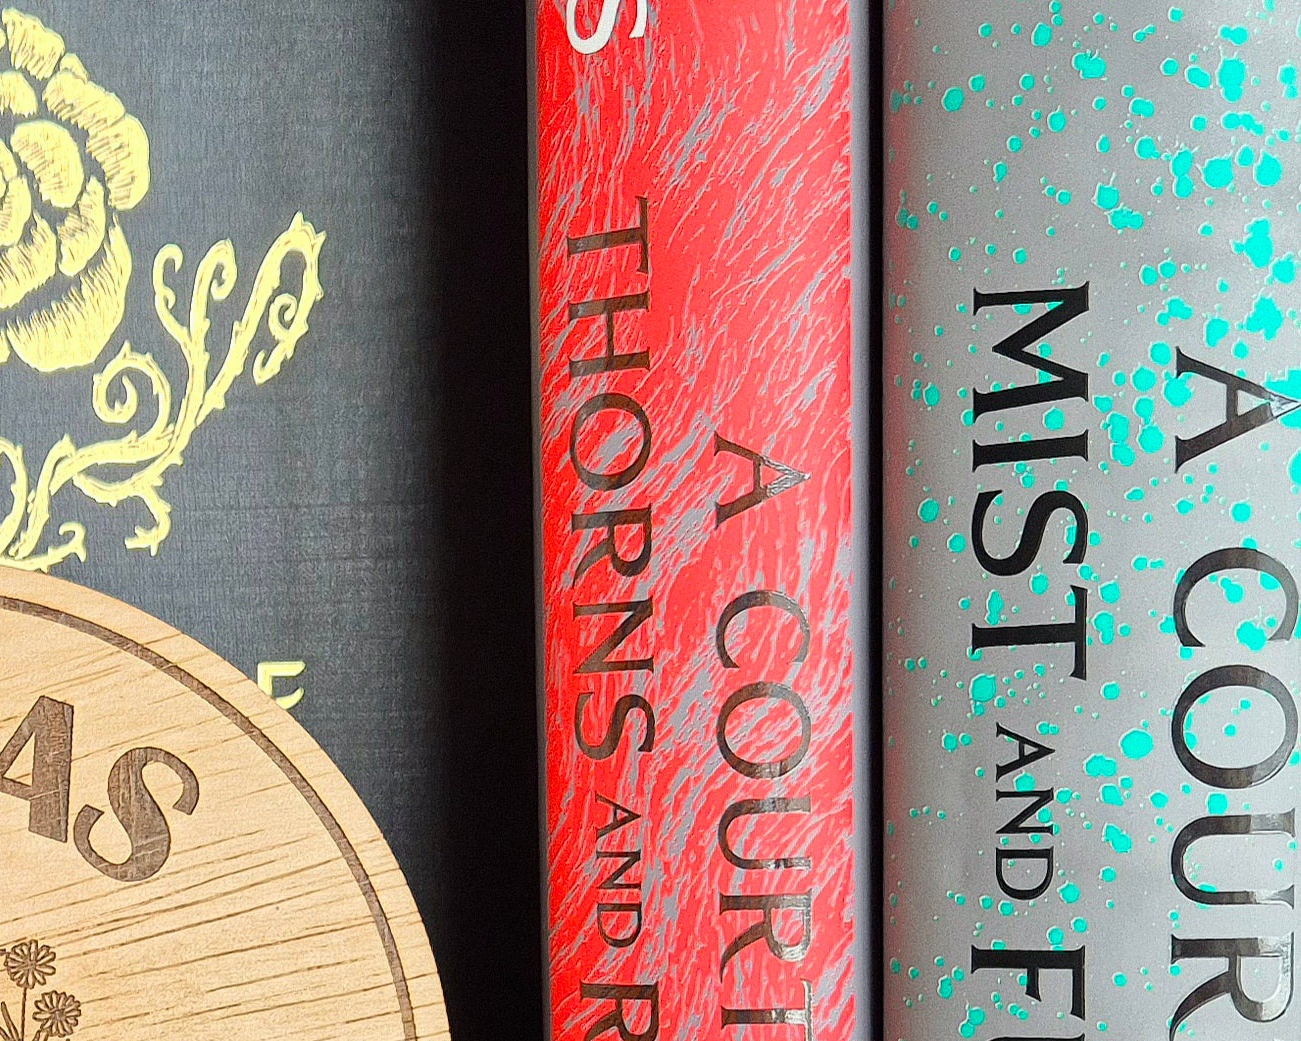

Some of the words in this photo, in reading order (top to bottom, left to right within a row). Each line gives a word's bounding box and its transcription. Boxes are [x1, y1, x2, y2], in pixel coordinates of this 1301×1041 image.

[566, 195, 656, 760] THORNS
[713, 431, 810, 530] A
[971, 281, 1090, 681] MIST
[1175, 345, 1301, 472] A
[595, 793, 643, 947] AND
[995, 722, 1056, 900] AND
